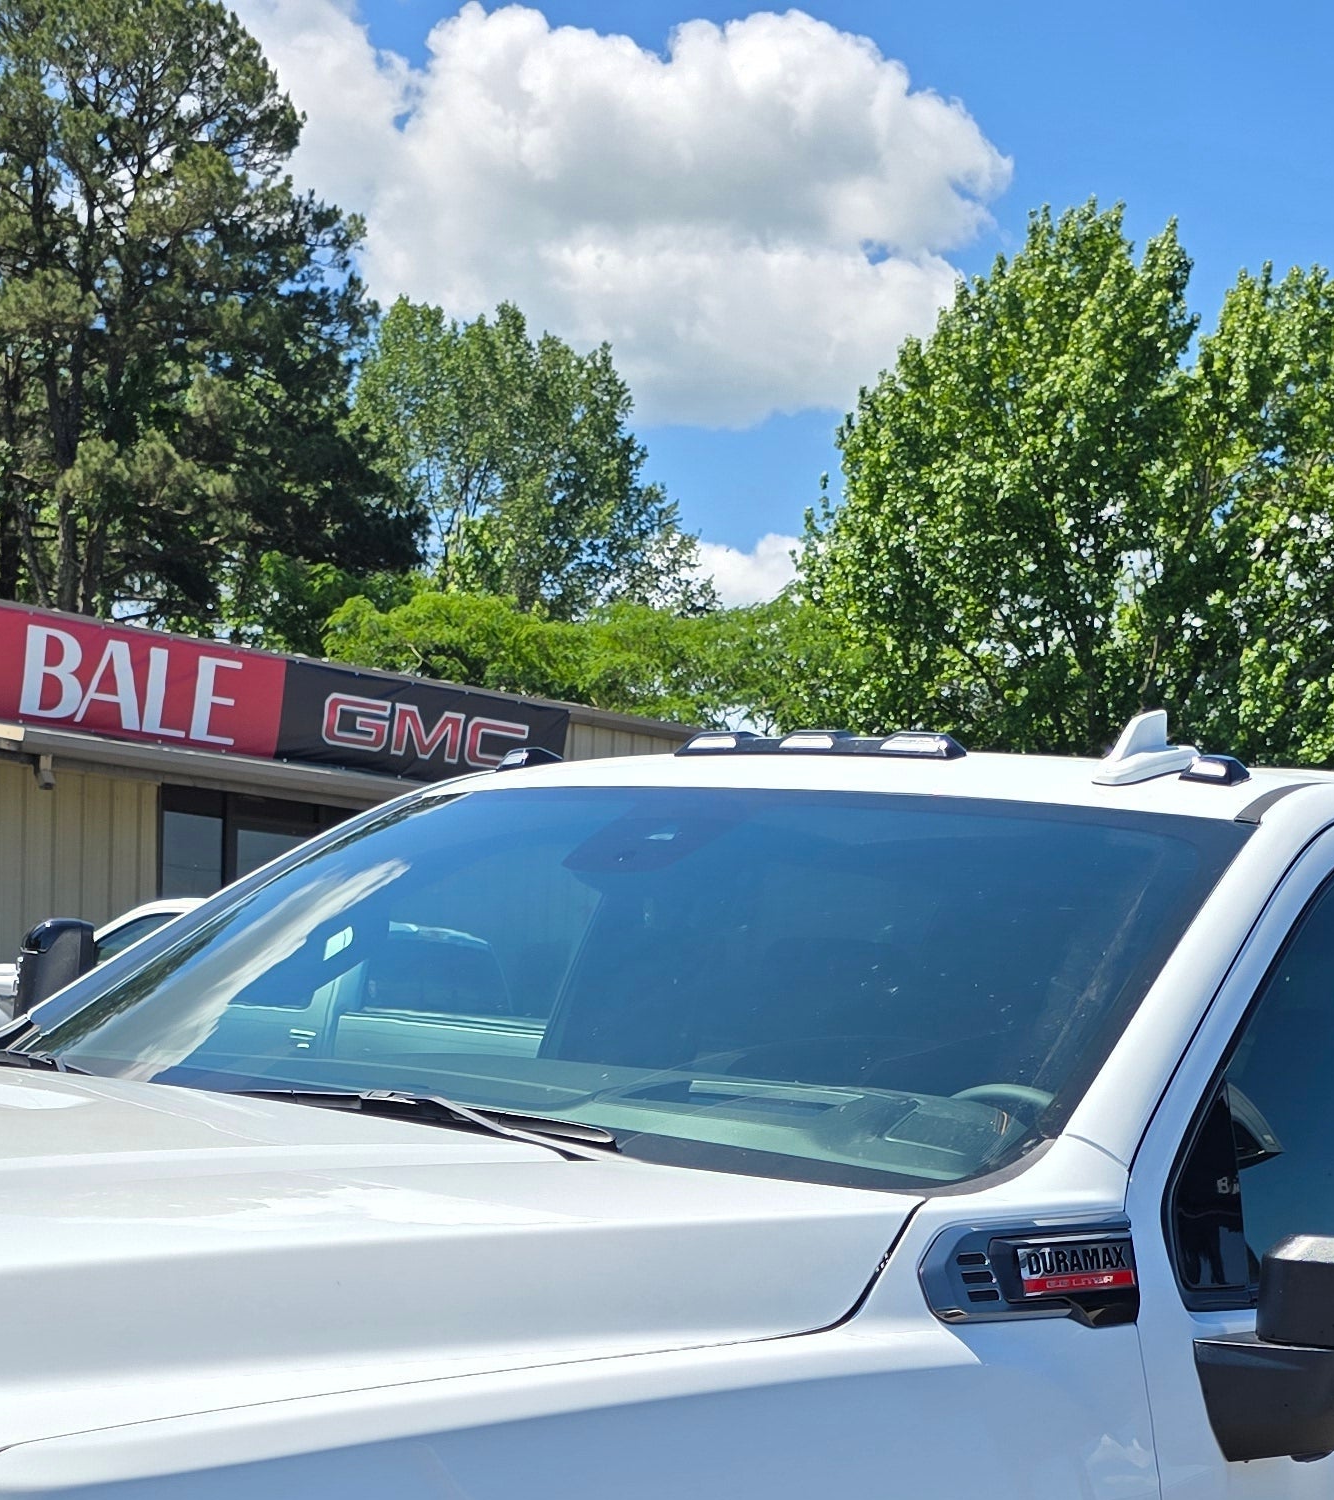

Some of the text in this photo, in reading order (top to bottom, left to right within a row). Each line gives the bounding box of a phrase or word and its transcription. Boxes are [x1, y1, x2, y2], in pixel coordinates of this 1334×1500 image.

[18, 624, 243, 746] BALE
[322, 692, 529, 769] GMC
[1028, 1246, 1126, 1275] DURAMAX
